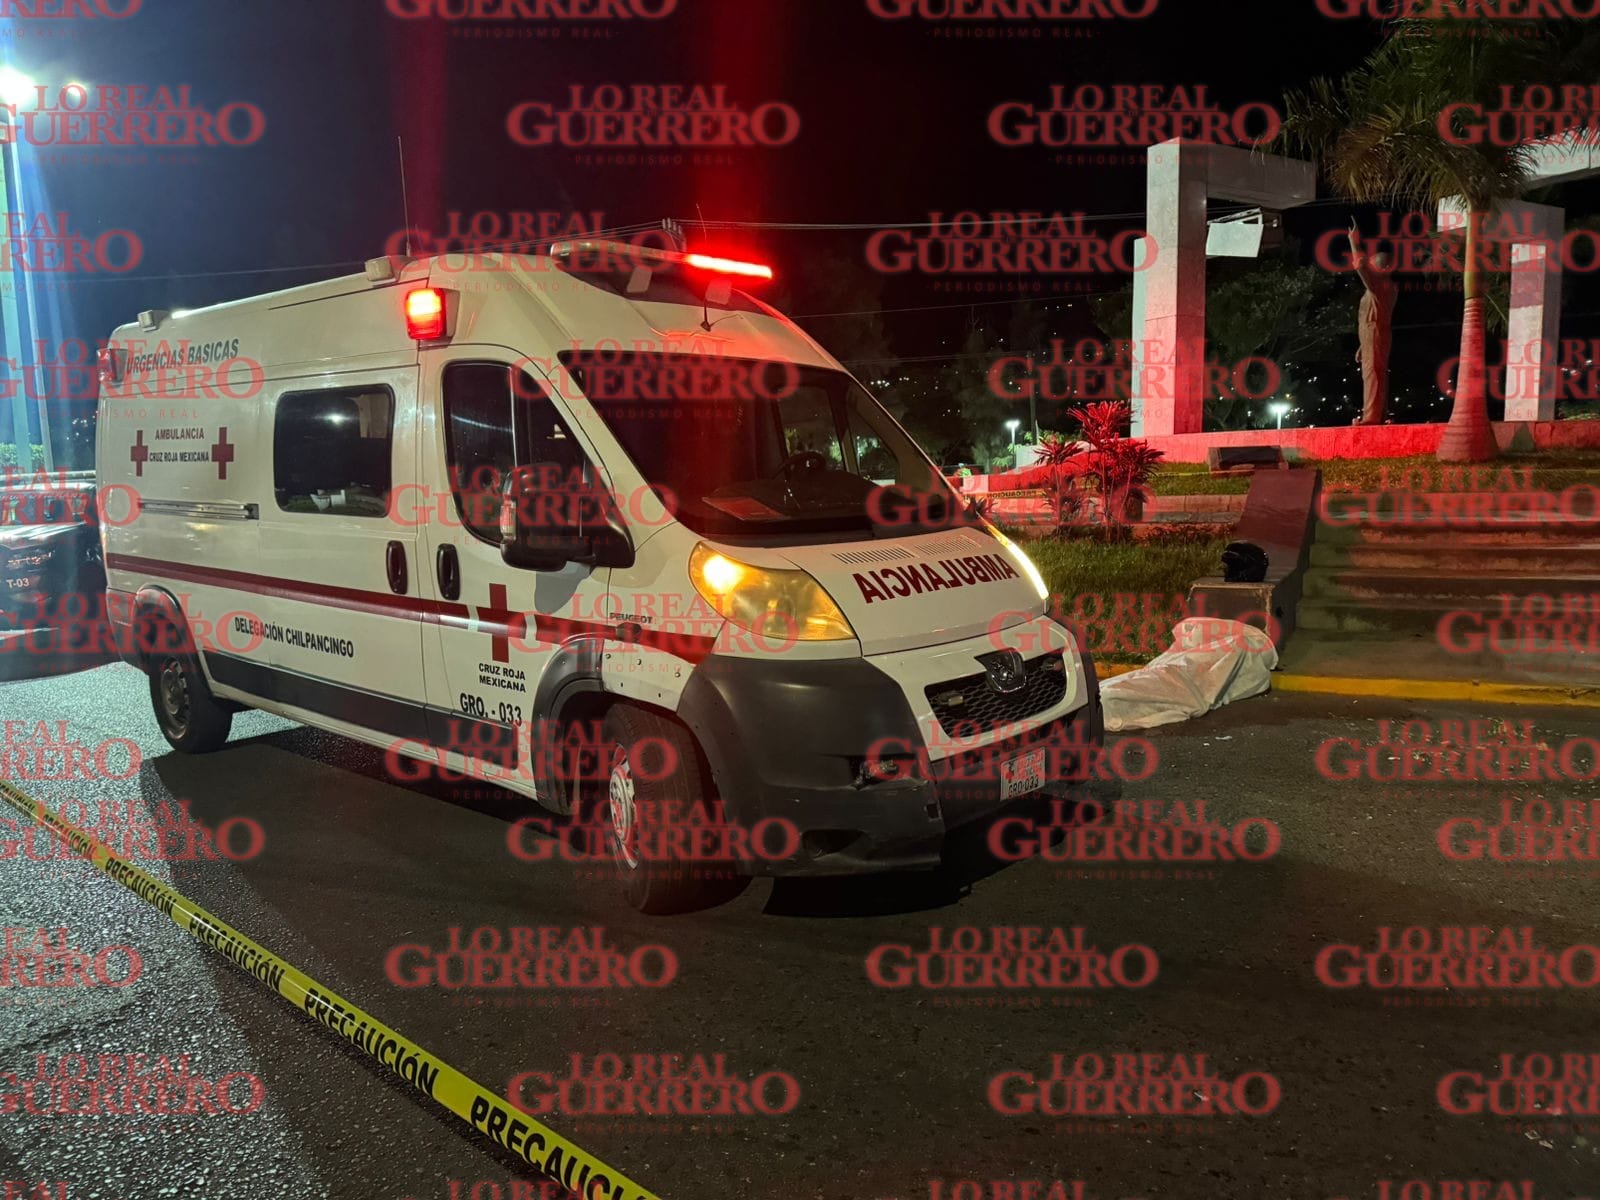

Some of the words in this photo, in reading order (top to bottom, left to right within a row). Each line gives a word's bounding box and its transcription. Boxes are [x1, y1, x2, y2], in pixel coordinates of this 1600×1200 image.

[127, 347, 185, 374] URGENCIAS
[187, 338, 239, 364] BASICAS
[155, 428, 204, 440] AMBULANCIA
[150, 453, 163, 462] CRUZ
[164, 453, 178, 462] ROJA
[179, 452, 210, 462] MEXICANA
[6, 578, 30, 589] T-03
[609, 612, 653, 624] PEUGEOT
[234, 617, 284, 642] DELEGACIÓN
[285, 628, 354, 658] CHILPANCINGO
[478, 662, 501, 675] CRUZ
[502, 667, 526, 680] ROJA
[479, 675, 527, 693] MEXICANA
[460, 692, 489, 718] GRO.
[499, 702, 523, 727] 033
[105, 857, 177, 918] PRECAUCIÓN
[189, 912, 286, 993] PRECAUCIÓN
[305, 987, 439, 1097] PRECAUCIÓN
